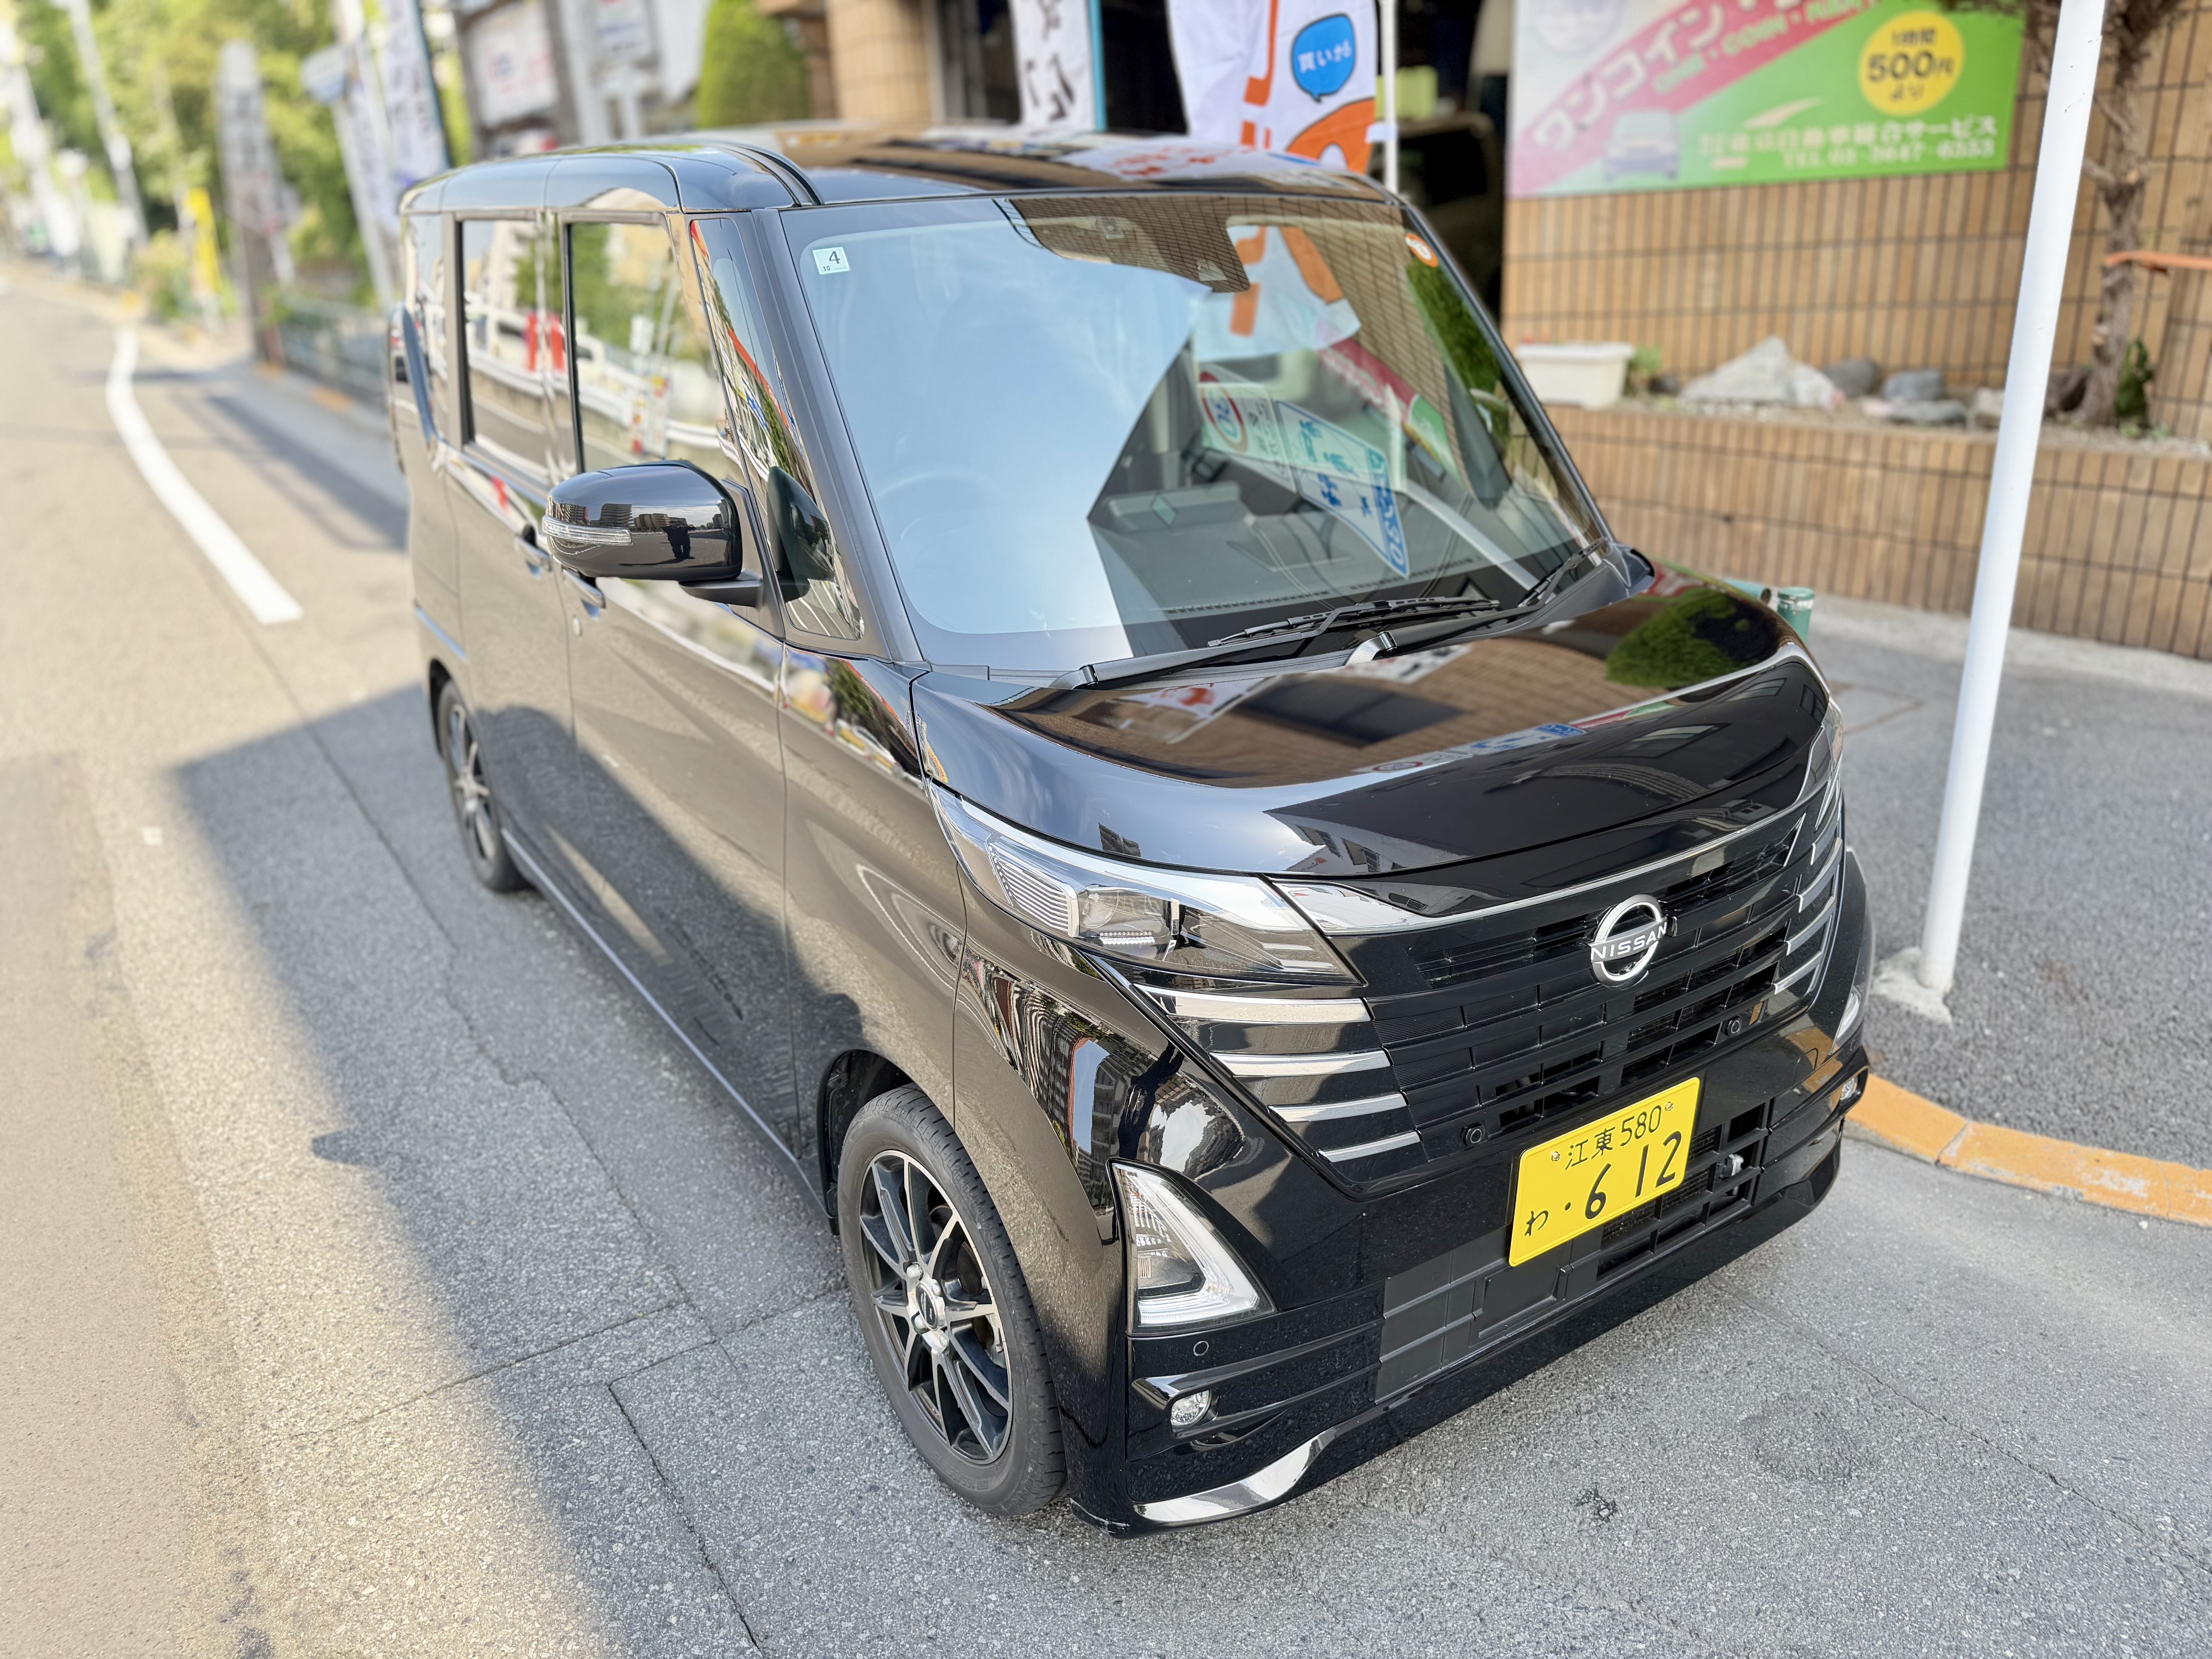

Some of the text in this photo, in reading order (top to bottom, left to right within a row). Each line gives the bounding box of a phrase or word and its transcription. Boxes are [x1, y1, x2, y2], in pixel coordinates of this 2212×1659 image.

[829, 251, 840, 264] 4
[1590, 921, 1668, 960] NISSAN
[1565, 1104, 1662, 1170] 江東 580
[1524, 1209, 1549, 1237] わ
